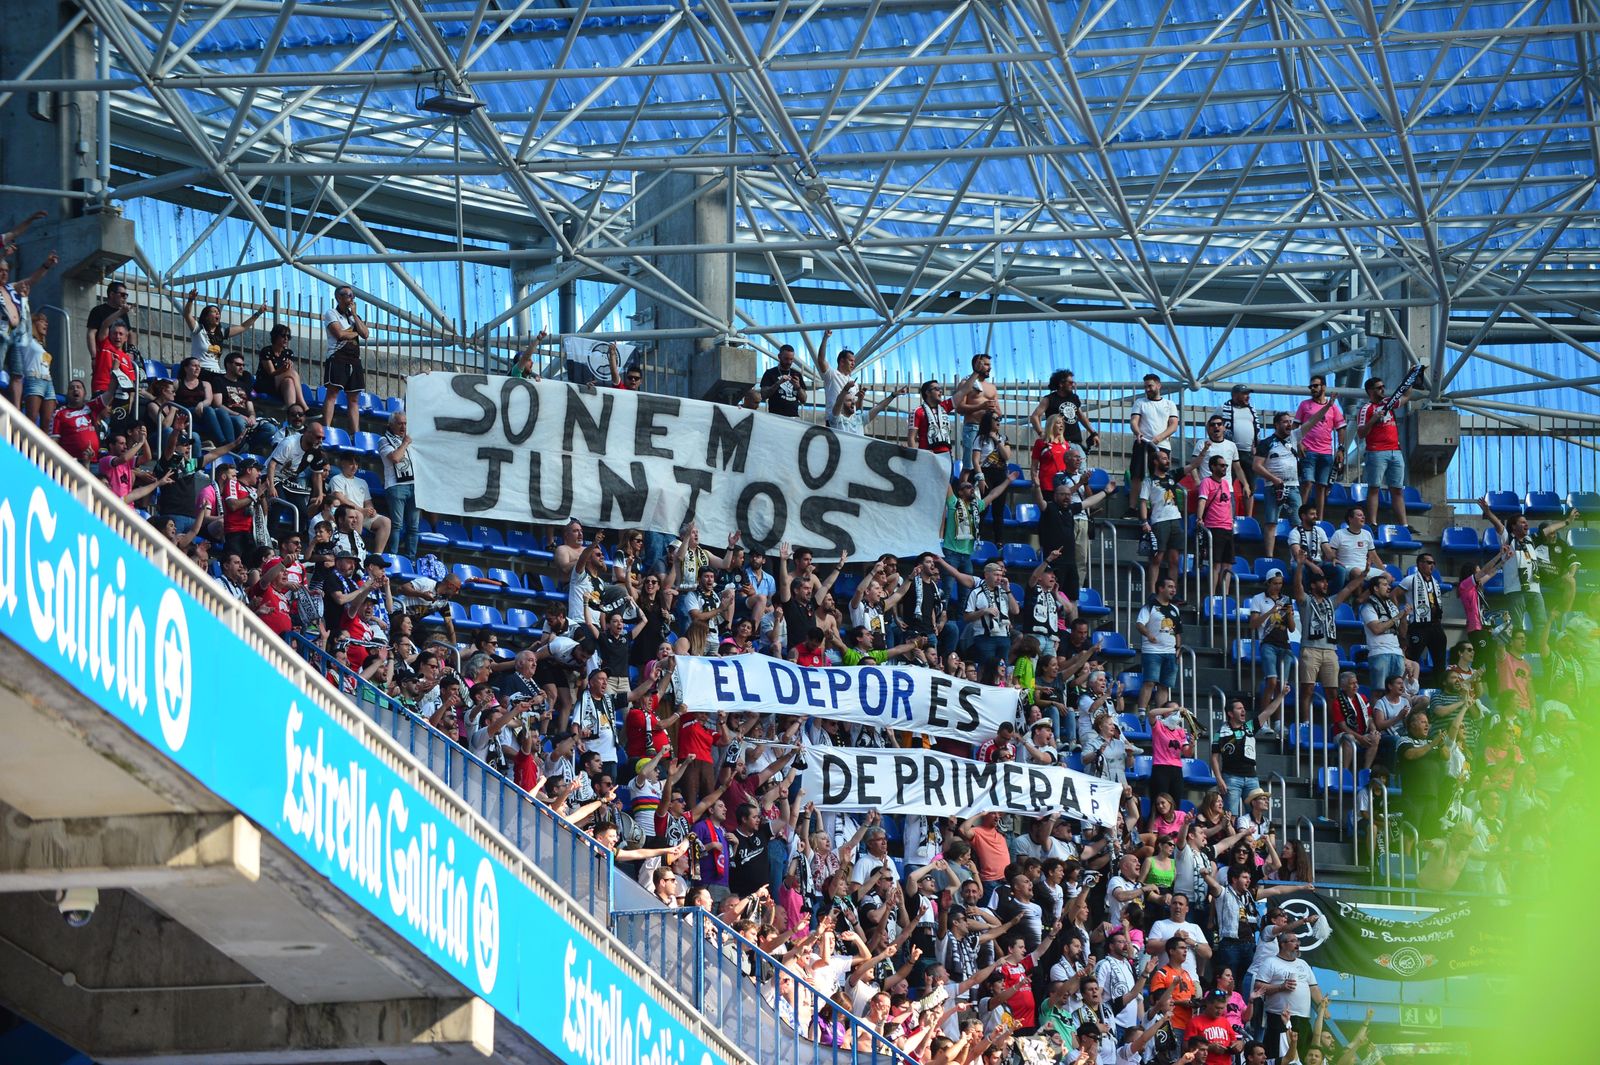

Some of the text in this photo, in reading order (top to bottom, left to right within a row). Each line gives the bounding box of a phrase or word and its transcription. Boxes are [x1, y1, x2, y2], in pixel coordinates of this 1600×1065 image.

[463, 447, 860, 557] JUNTOS
[25, 486, 148, 717] Galicia
[709, 659, 982, 732] EL DEPOR ES
[822, 755, 1082, 814] DE PRIMERA
[283, 700, 469, 968] Estrella Galicia
[1203, 1027, 1229, 1040] TOMMY
